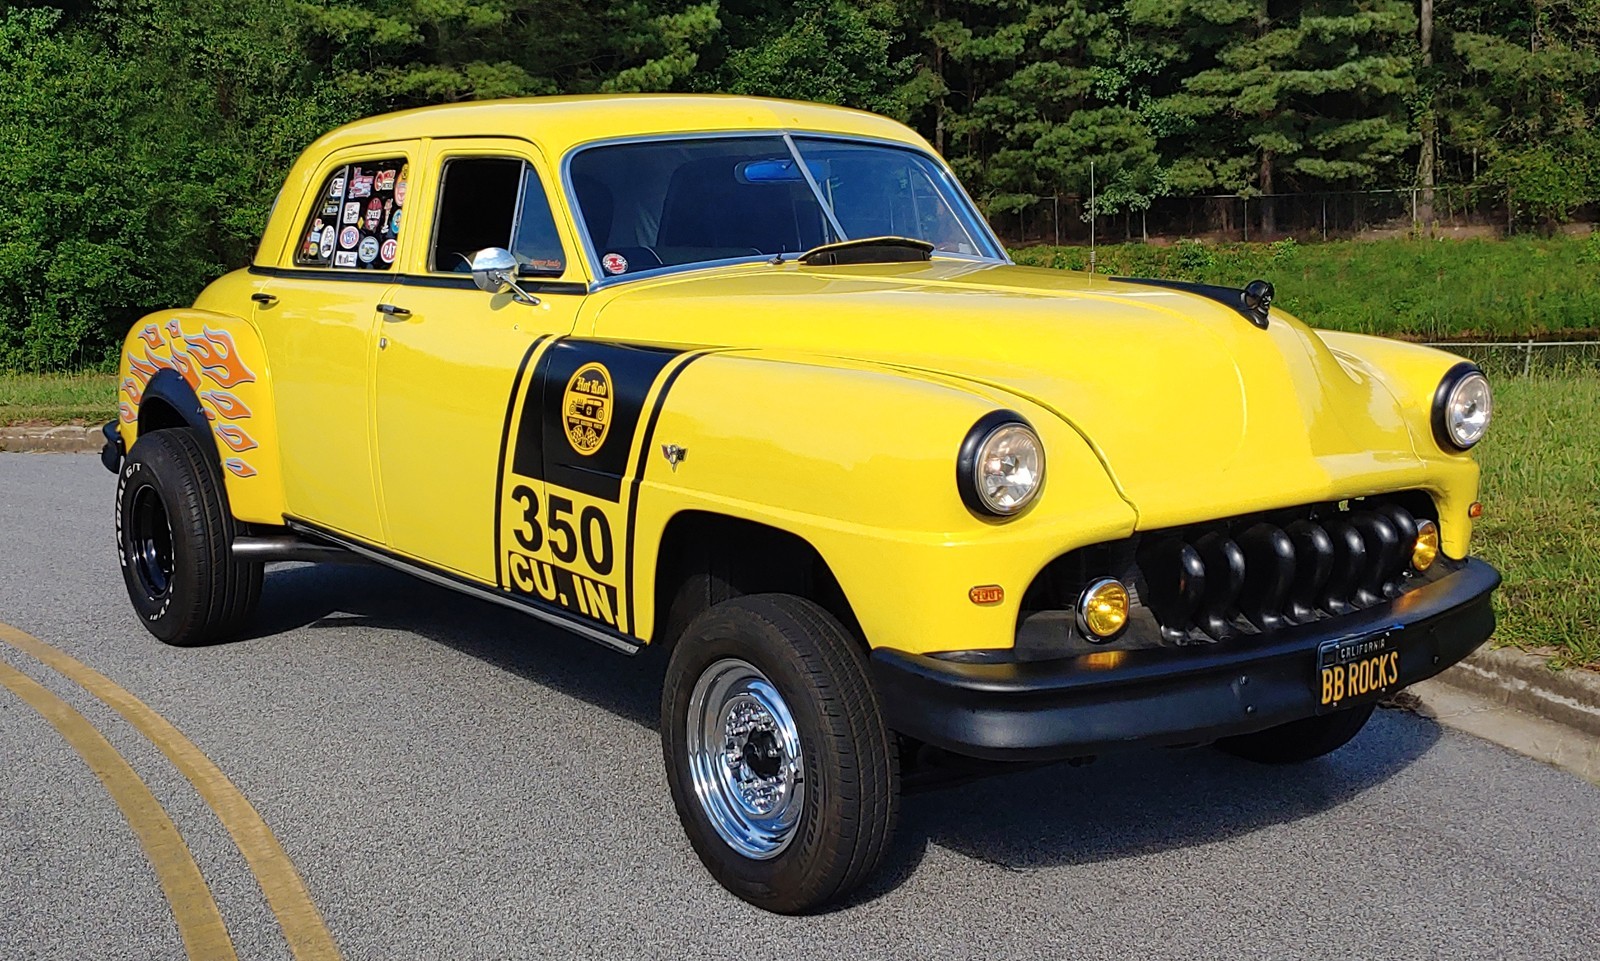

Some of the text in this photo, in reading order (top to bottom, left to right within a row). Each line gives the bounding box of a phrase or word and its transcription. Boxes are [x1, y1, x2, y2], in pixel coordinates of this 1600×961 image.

[383, 243, 397, 259] RAT
[575, 377, 607, 396] Hot Rod
[125, 462, 142, 479] G/T
[511, 484, 614, 577] 350
[509, 553, 569, 606] CU.
[1340, 638, 1385, 659] CALIFORNIA
[1321, 651, 1399, 705] BB ROCKS
